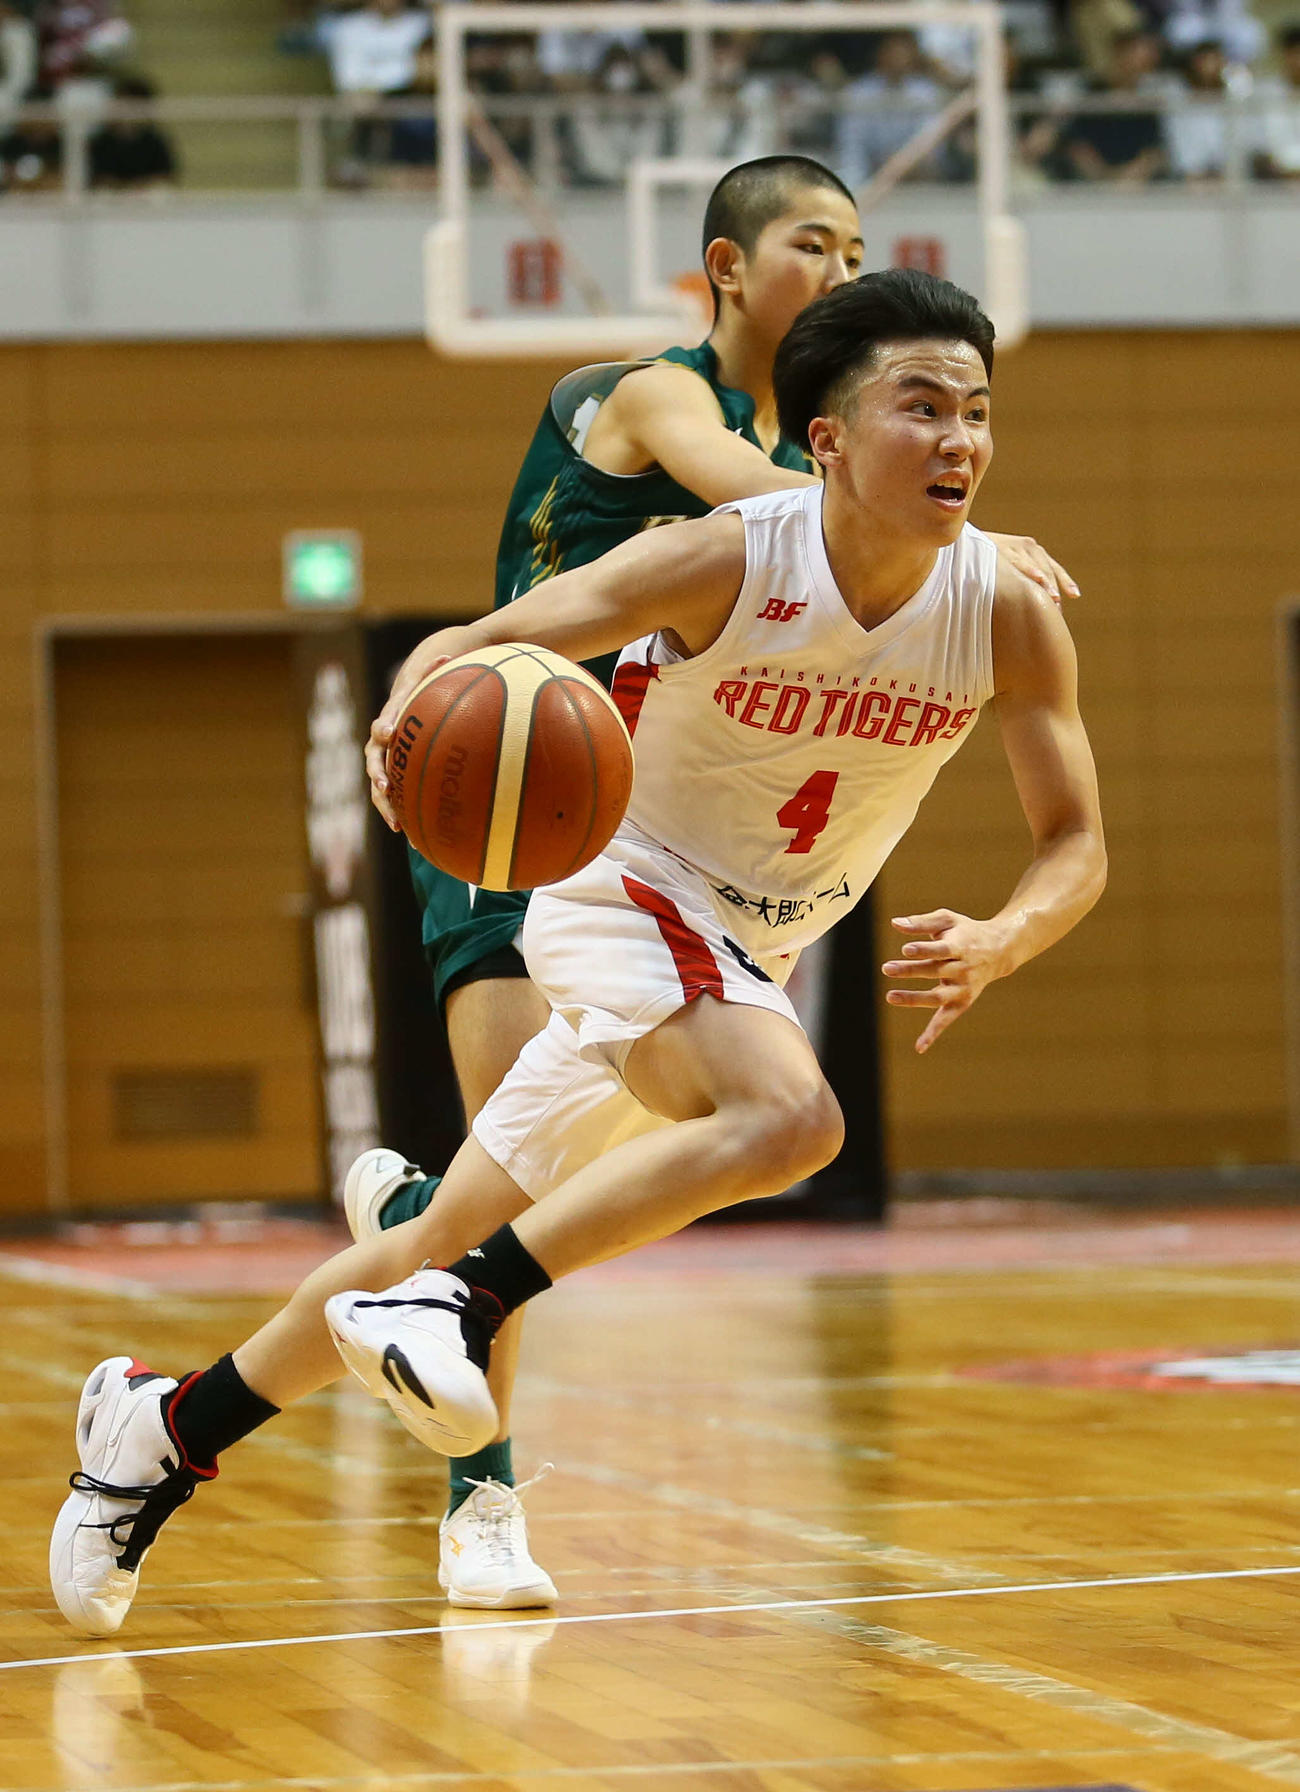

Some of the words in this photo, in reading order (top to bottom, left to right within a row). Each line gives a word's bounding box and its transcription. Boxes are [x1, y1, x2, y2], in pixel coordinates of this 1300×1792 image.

[713, 680, 811, 735] RED
[812, 689, 977, 747] TIGERS
[740, 665, 968, 704] KAISHIKOKUSAI
[776, 770, 840, 854] 4
